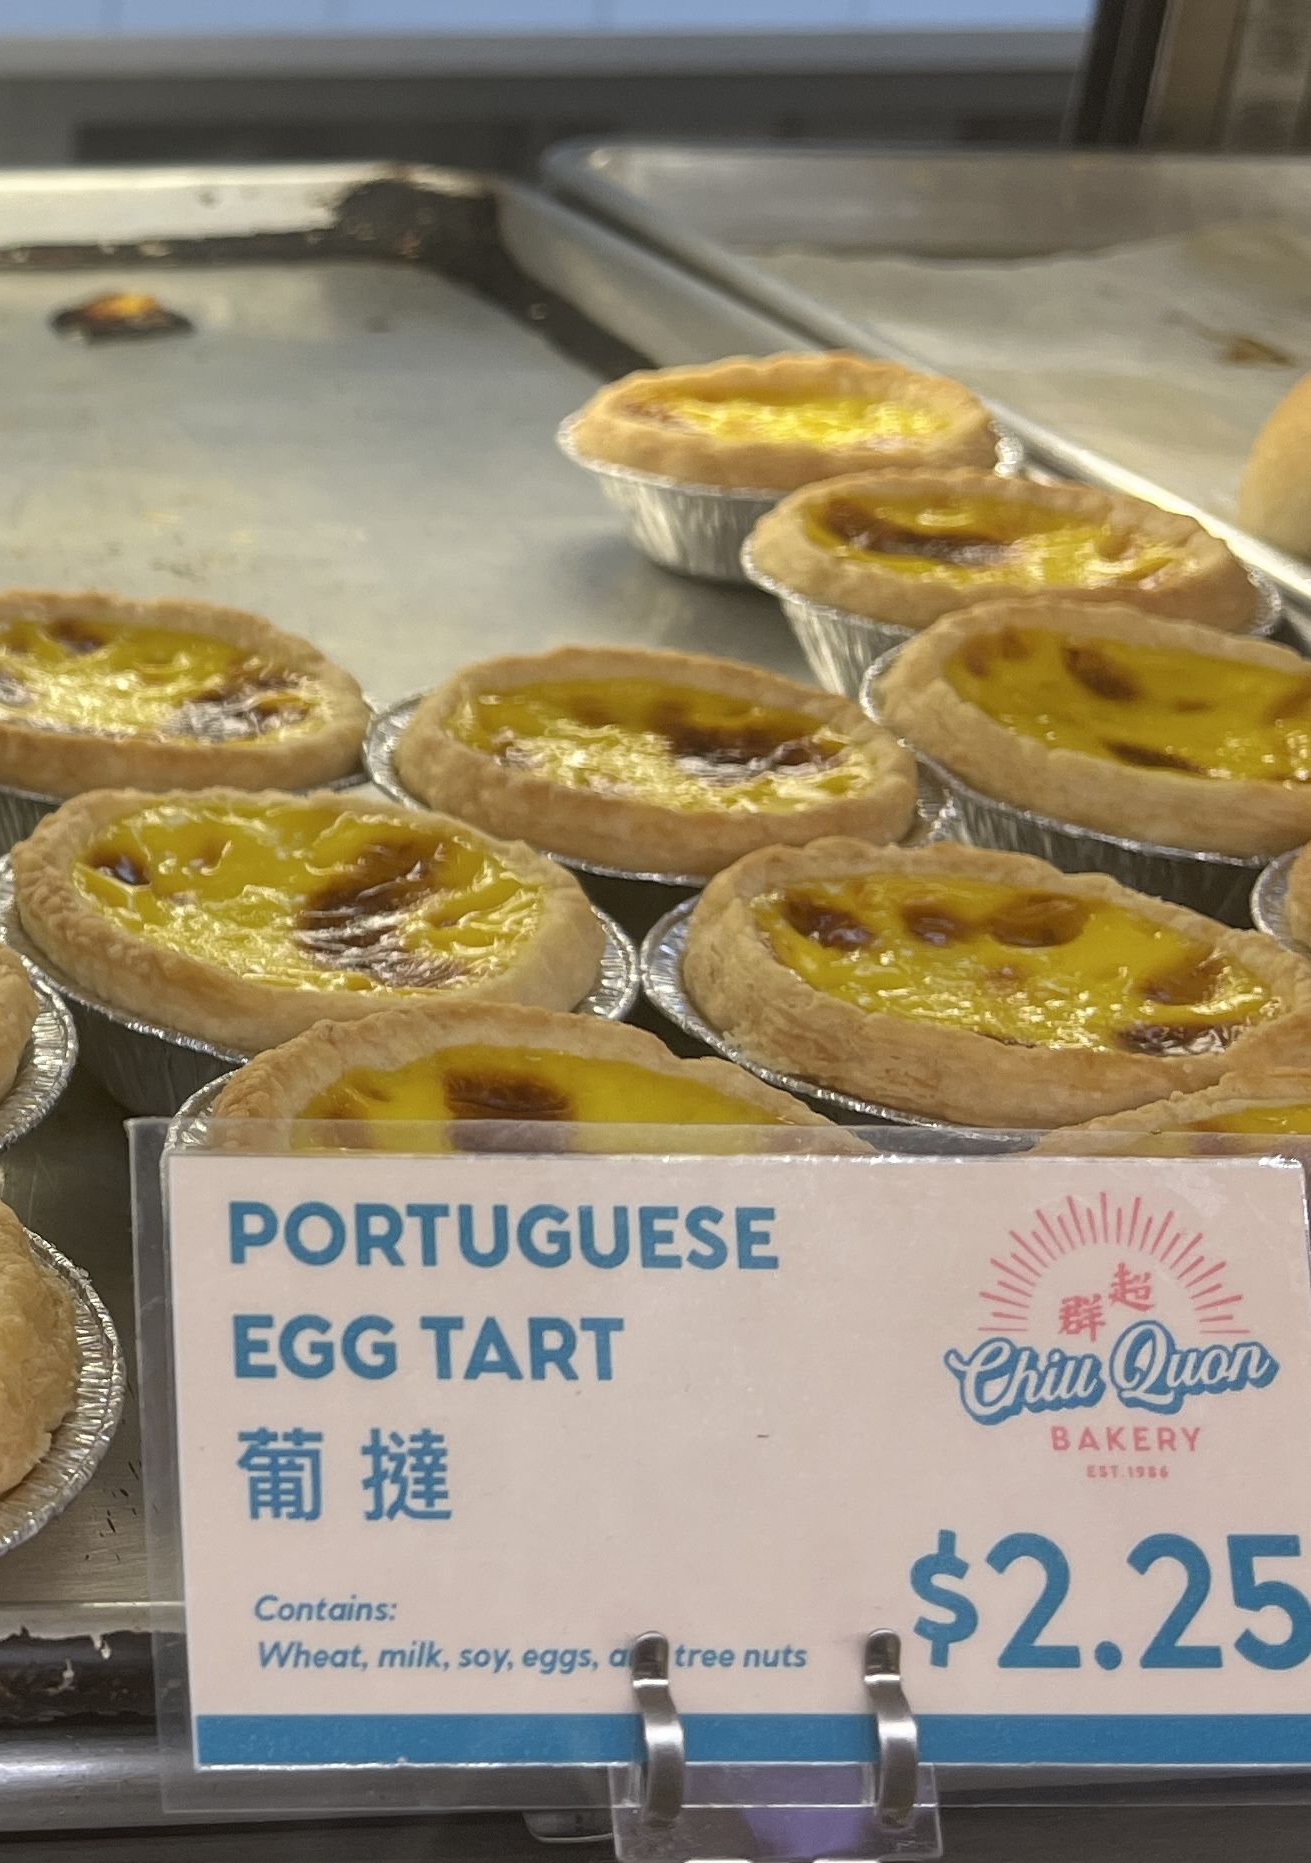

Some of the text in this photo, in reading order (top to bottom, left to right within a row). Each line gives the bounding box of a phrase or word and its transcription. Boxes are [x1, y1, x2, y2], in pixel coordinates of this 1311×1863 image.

[228, 1200, 781, 1271] PORTUGUESE
[232, 1313, 626, 1383] EGG TART
[943, 1320, 1280, 1426] Chiu Quon
[1050, 1425, 1202, 1452] BAKERY
[253, 1594, 398, 1624] Contains:
[910, 1529, 1311, 1672] $2.25
[258, 1640, 369, 1672] Wheat,
[377, 1640, 451, 1671] milk,
[458, 1648, 515, 1675] soy,
[522, 1648, 599, 1677] eggs,
[674, 1644, 737, 1669] tree
[742, 1646, 809, 1669] nuts
